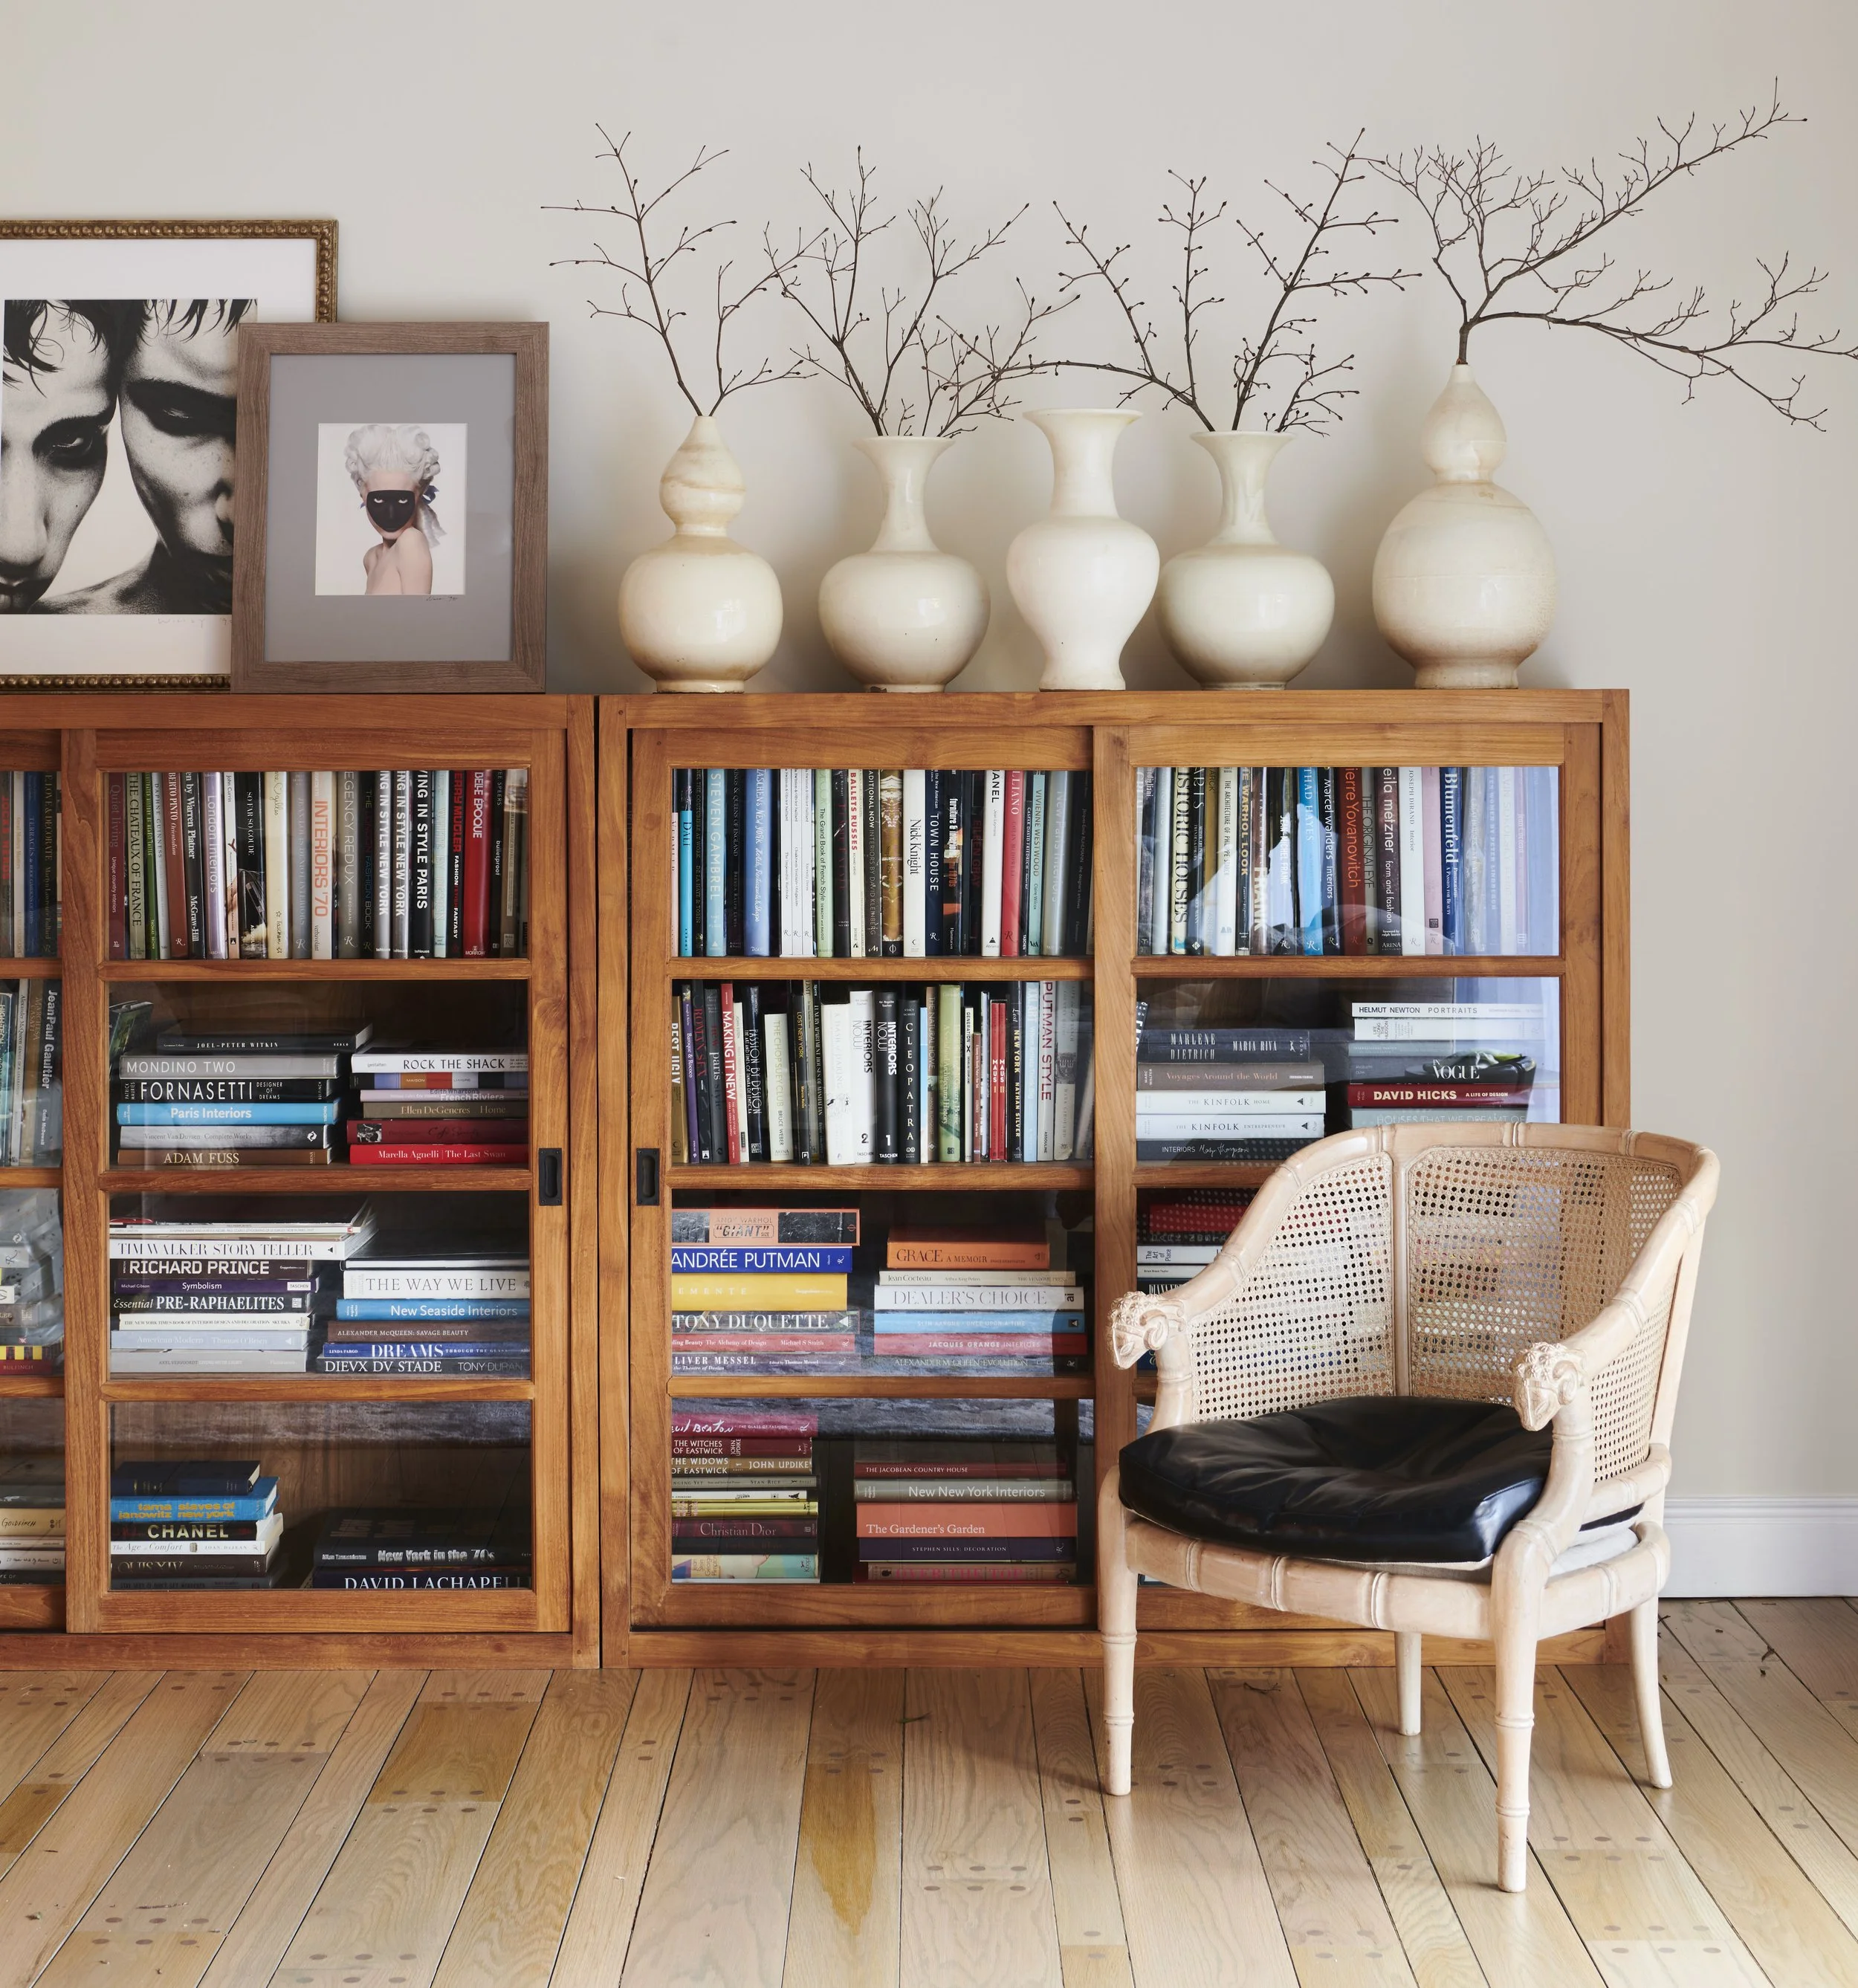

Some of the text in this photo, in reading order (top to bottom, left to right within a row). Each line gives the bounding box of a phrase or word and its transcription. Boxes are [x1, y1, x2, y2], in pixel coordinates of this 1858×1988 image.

[1444, 773, 1458, 863] Blumenfeld
[1383, 800, 1394, 853] metzner
[710, 773, 721, 901] STEVEN GAMBREL
[129, 773, 141, 926] THE CHATEAUX OF FRANCE
[207, 795, 217, 893] London Interiors
[907, 819, 922, 875] Nick Knight
[1346, 803, 1359, 887] Yovanovitch
[417, 803, 428, 909] IN STYLE PARIS
[930, 813, 939, 891] TOWN HOUSE
[1042, 982, 1052, 1101] PUTMAN STYLE
[1171, 1033, 1215, 1045] MARLENE
[862, 1020, 873, 1073] INTERIORS
[887, 1022, 896, 1075] INTERIORS
[1233, 1041, 1277, 1051] MARIA RIVA
[722, 1011, 737, 1100] MAKING IT NEW
[1171, 1049, 1215, 1060] DIETRICH
[42, 1044, 54, 1088] Gaultier
[126, 1061, 236, 1073] MONDINO TWO
[404, 1059, 505, 1069] ROCK THE SHACK
[1433, 1065, 1480, 1078] VOGUE
[141, 1082, 252, 1100] FORNASETTI
[1373, 1091, 1414, 1100] DAVID
[1417, 1091, 1457, 1100] HICKS
[171, 1107, 251, 1119] Paris Interiors
[164, 1153, 239, 1164] ADAM FUSS
[409, 1150, 439, 1159] Agnelli
[896, 1249, 942, 1262] GRACE
[129, 1260, 269, 1275] RICHARD PRINCE
[182, 1282, 222, 1290] Symbolism
[366, 1278, 516, 1290] THE WAY WE LIVE
[114, 1296, 284, 1310] Essential PRE-RAPHAELITES
[391, 1305, 517, 1315] New Seaside Interiors
[672, 1315, 829, 1332] TONY DUQUETTE
[909, 1486, 1045, 1497] New New York Interiors
[148, 1525, 228, 1538] CHANEL
[700, 1523, 777, 1537] Christian Dior
[867, 1524, 887, 1534] The
[947, 1524, 985, 1534] Garden
[378, 1549, 495, 1561] New York in the 70s
[345, 1578, 404, 1588] DAVID
